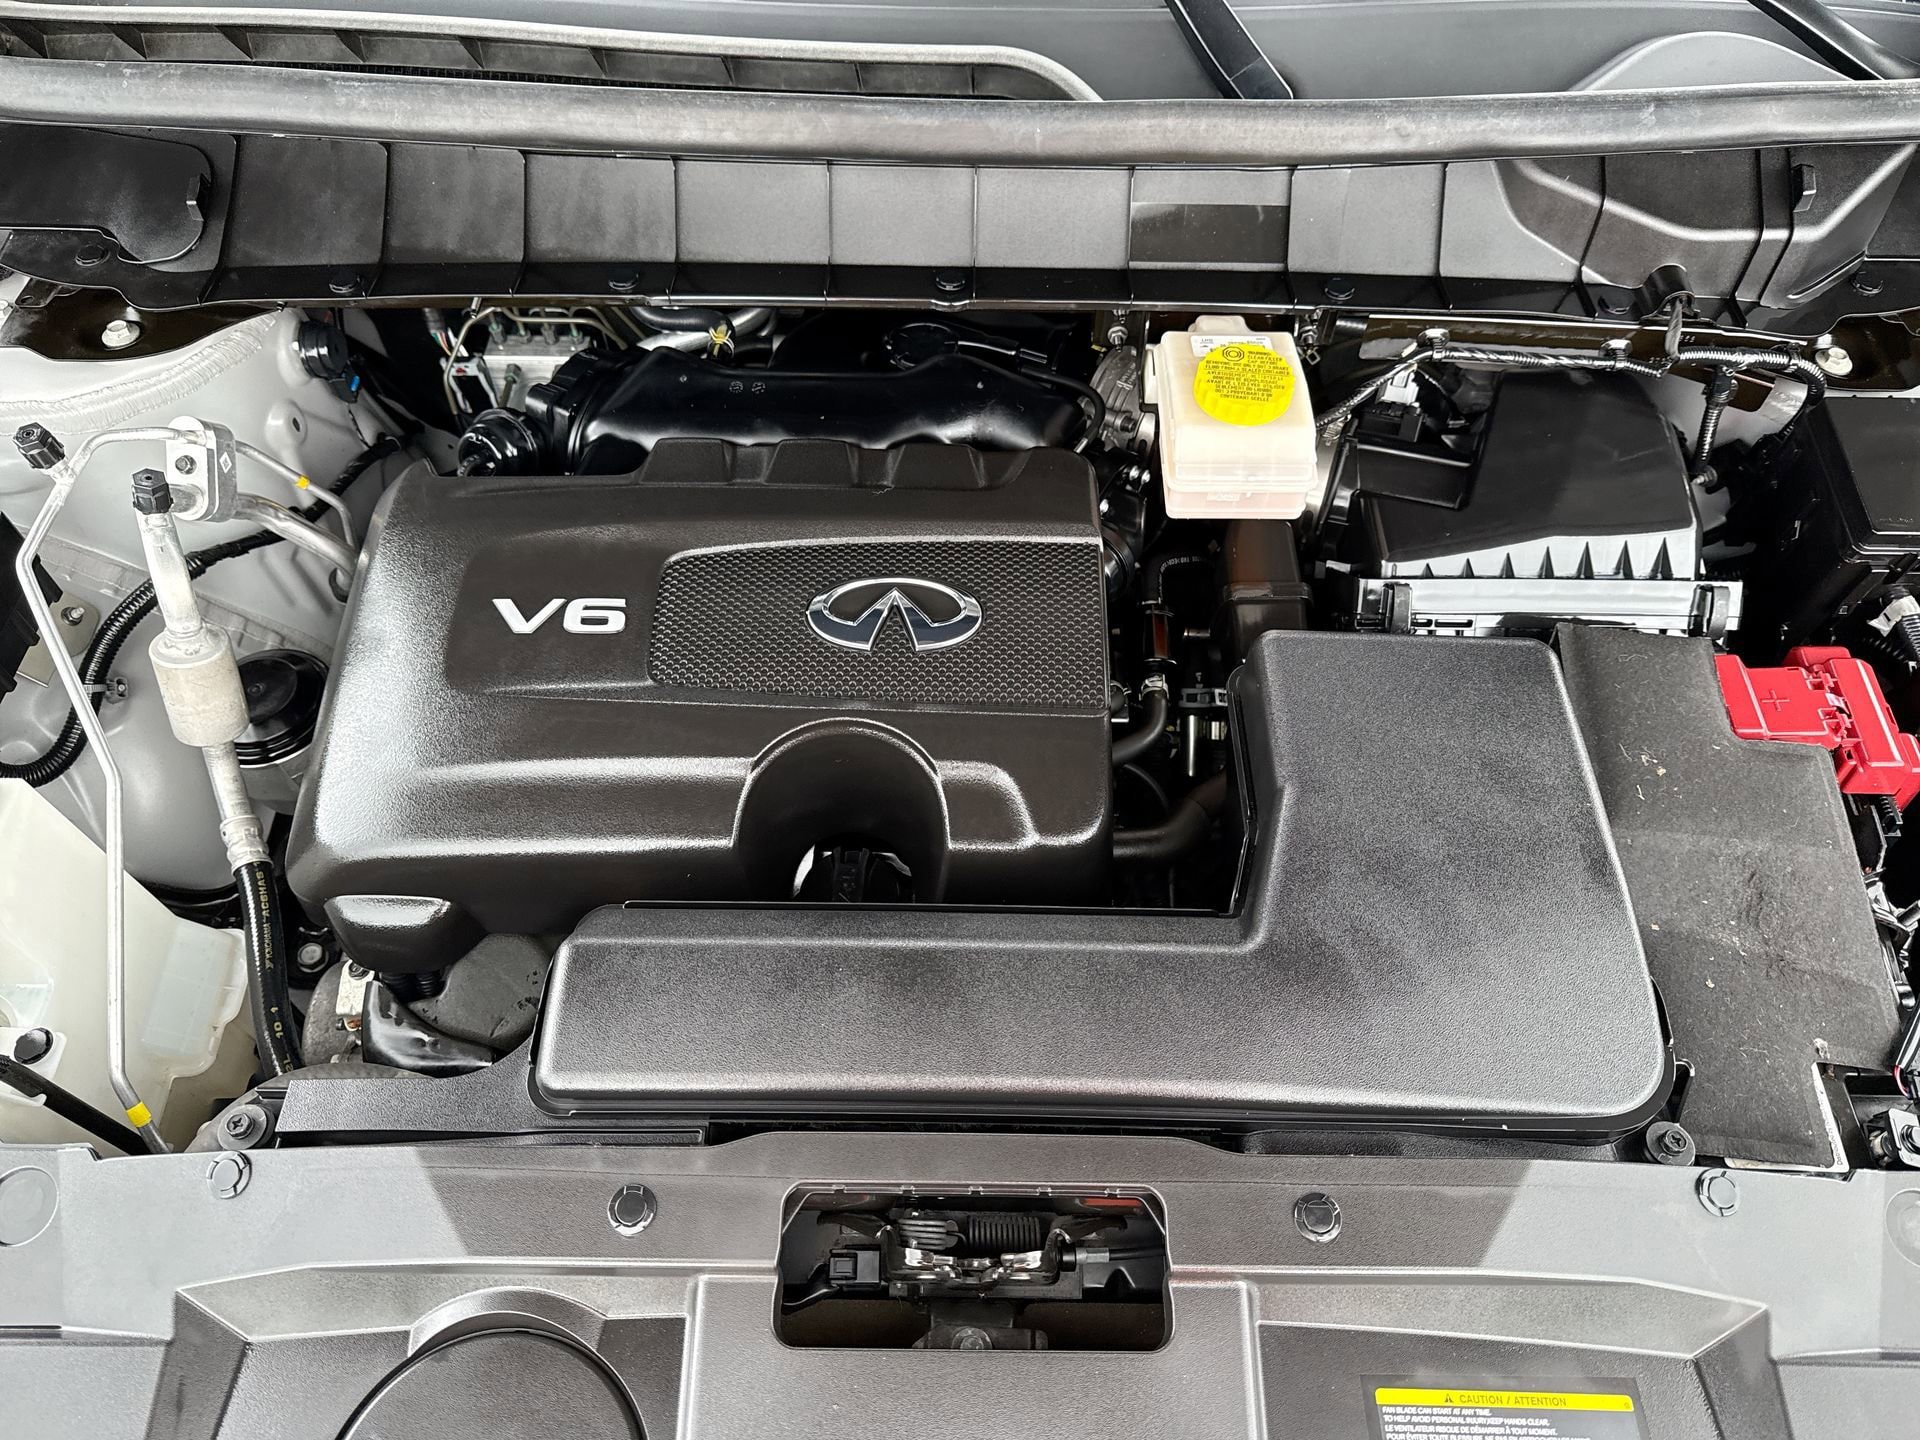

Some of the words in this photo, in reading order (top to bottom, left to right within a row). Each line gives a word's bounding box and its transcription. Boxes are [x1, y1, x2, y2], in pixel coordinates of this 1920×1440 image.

[492, 597, 627, 634] V6
[273, 1021, 284, 1039] 10
[1459, 1394, 1503, 1405] CAUTION
[1514, 1396, 1567, 1406] ATTENTION
[1382, 1406, 1396, 1414] FAN
[1396, 1407, 1417, 1415] BLADE
[1417, 1407, 1432, 1415] CAN
[1432, 1407, 1452, 1415] START
[1452, 1407, 1461, 1416] AT
[1461, 1408, 1474, 1416] ANY
[1394, 1415, 1411, 1423] HELP
[1411, 1416, 1431, 1424] AVOID
[1432, 1416, 1466, 1424] PERSONAL
[1504, 1417, 1526, 1426] HANDS
[1527, 1418, 1550, 1427] CLEAR.
[1394, 1425, 1435, 1433] VENTILATEUR
[1435, 1426, 1460, 1434] RISQUE
[1460, 1426, 1470, 1434] DE
[1470, 1425, 1505, 1434] DÉMARRER
[1511, 1427, 1528, 1435] TOUT
[1528, 1427, 1558, 1436] MOMENT.
